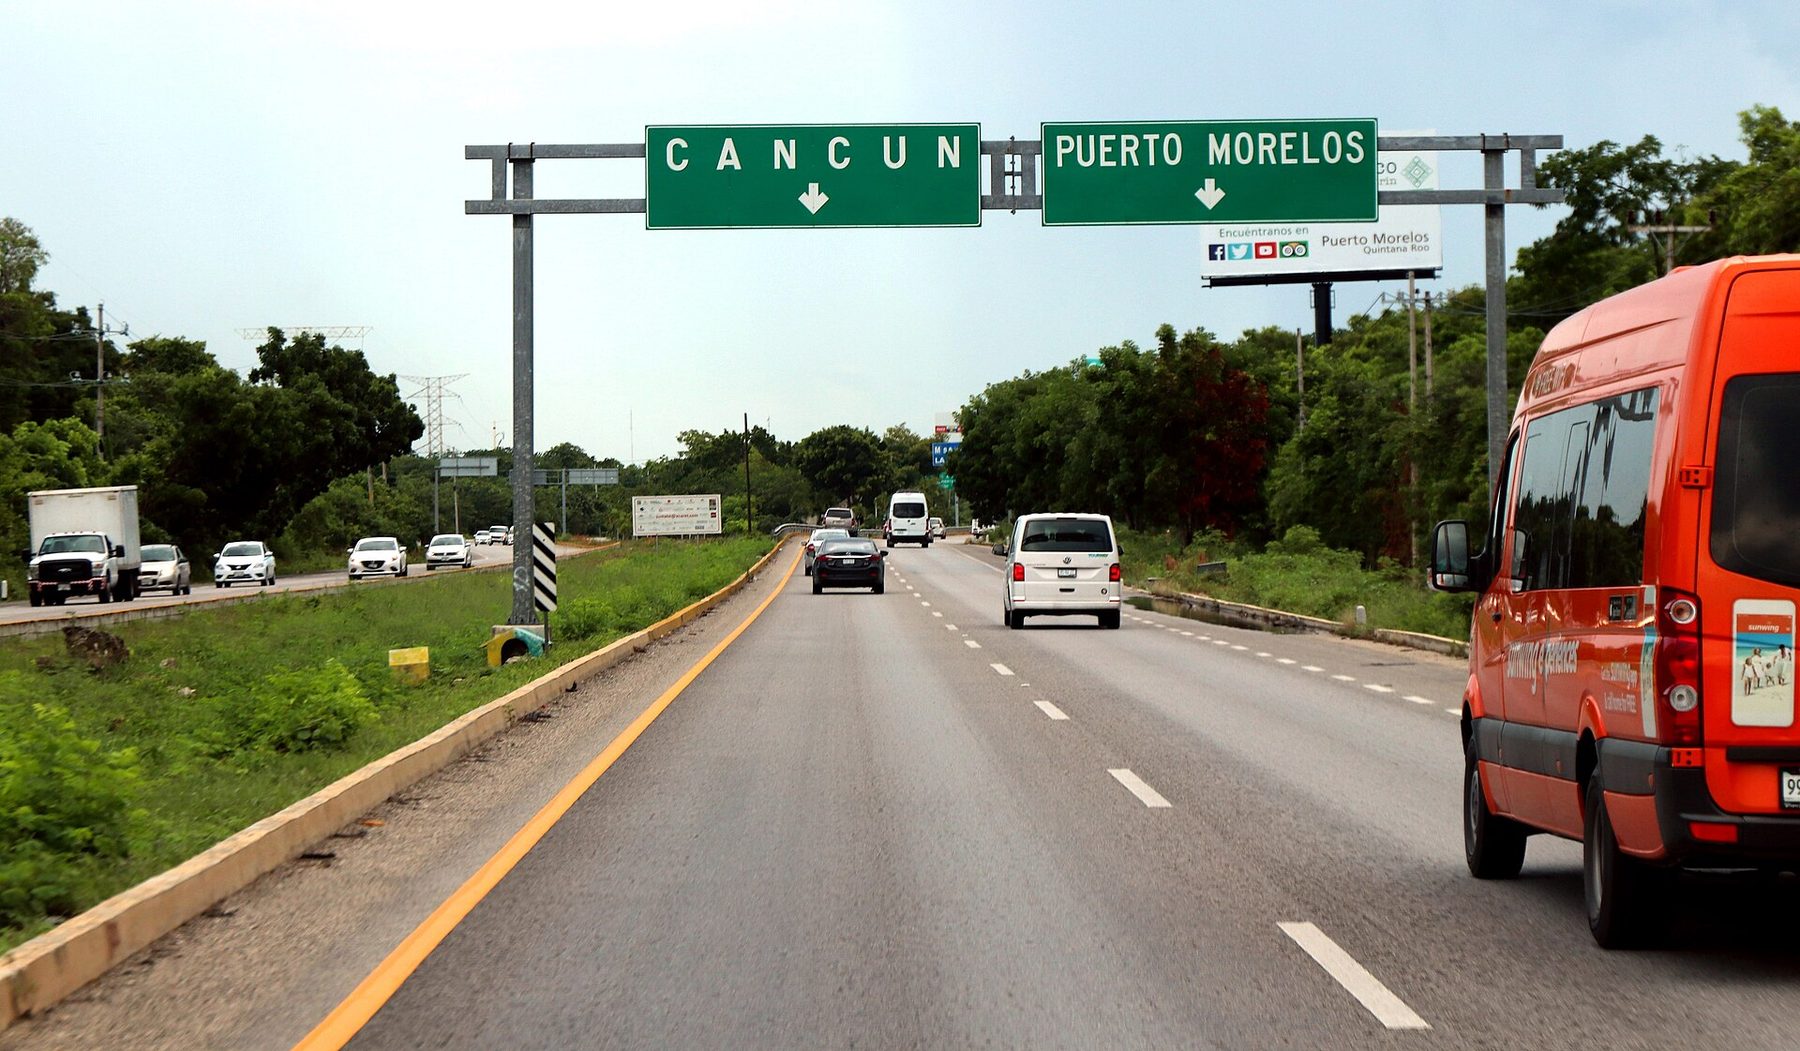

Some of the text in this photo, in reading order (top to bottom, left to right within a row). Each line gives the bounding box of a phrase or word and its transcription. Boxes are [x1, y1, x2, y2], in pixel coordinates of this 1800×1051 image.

[666, 136, 960, 171] CANCUN
[1055, 130, 1366, 168] PUERTO MORELOS
[1219, 226, 1309, 239] Encuéntranos en
[1322, 231, 1430, 248] Puerto Morelos
[1363, 244, 1430, 255] Quintana Roo
[1748, 624, 1780, 634] sunwing
[1538, 640, 1580, 683] eperiences
